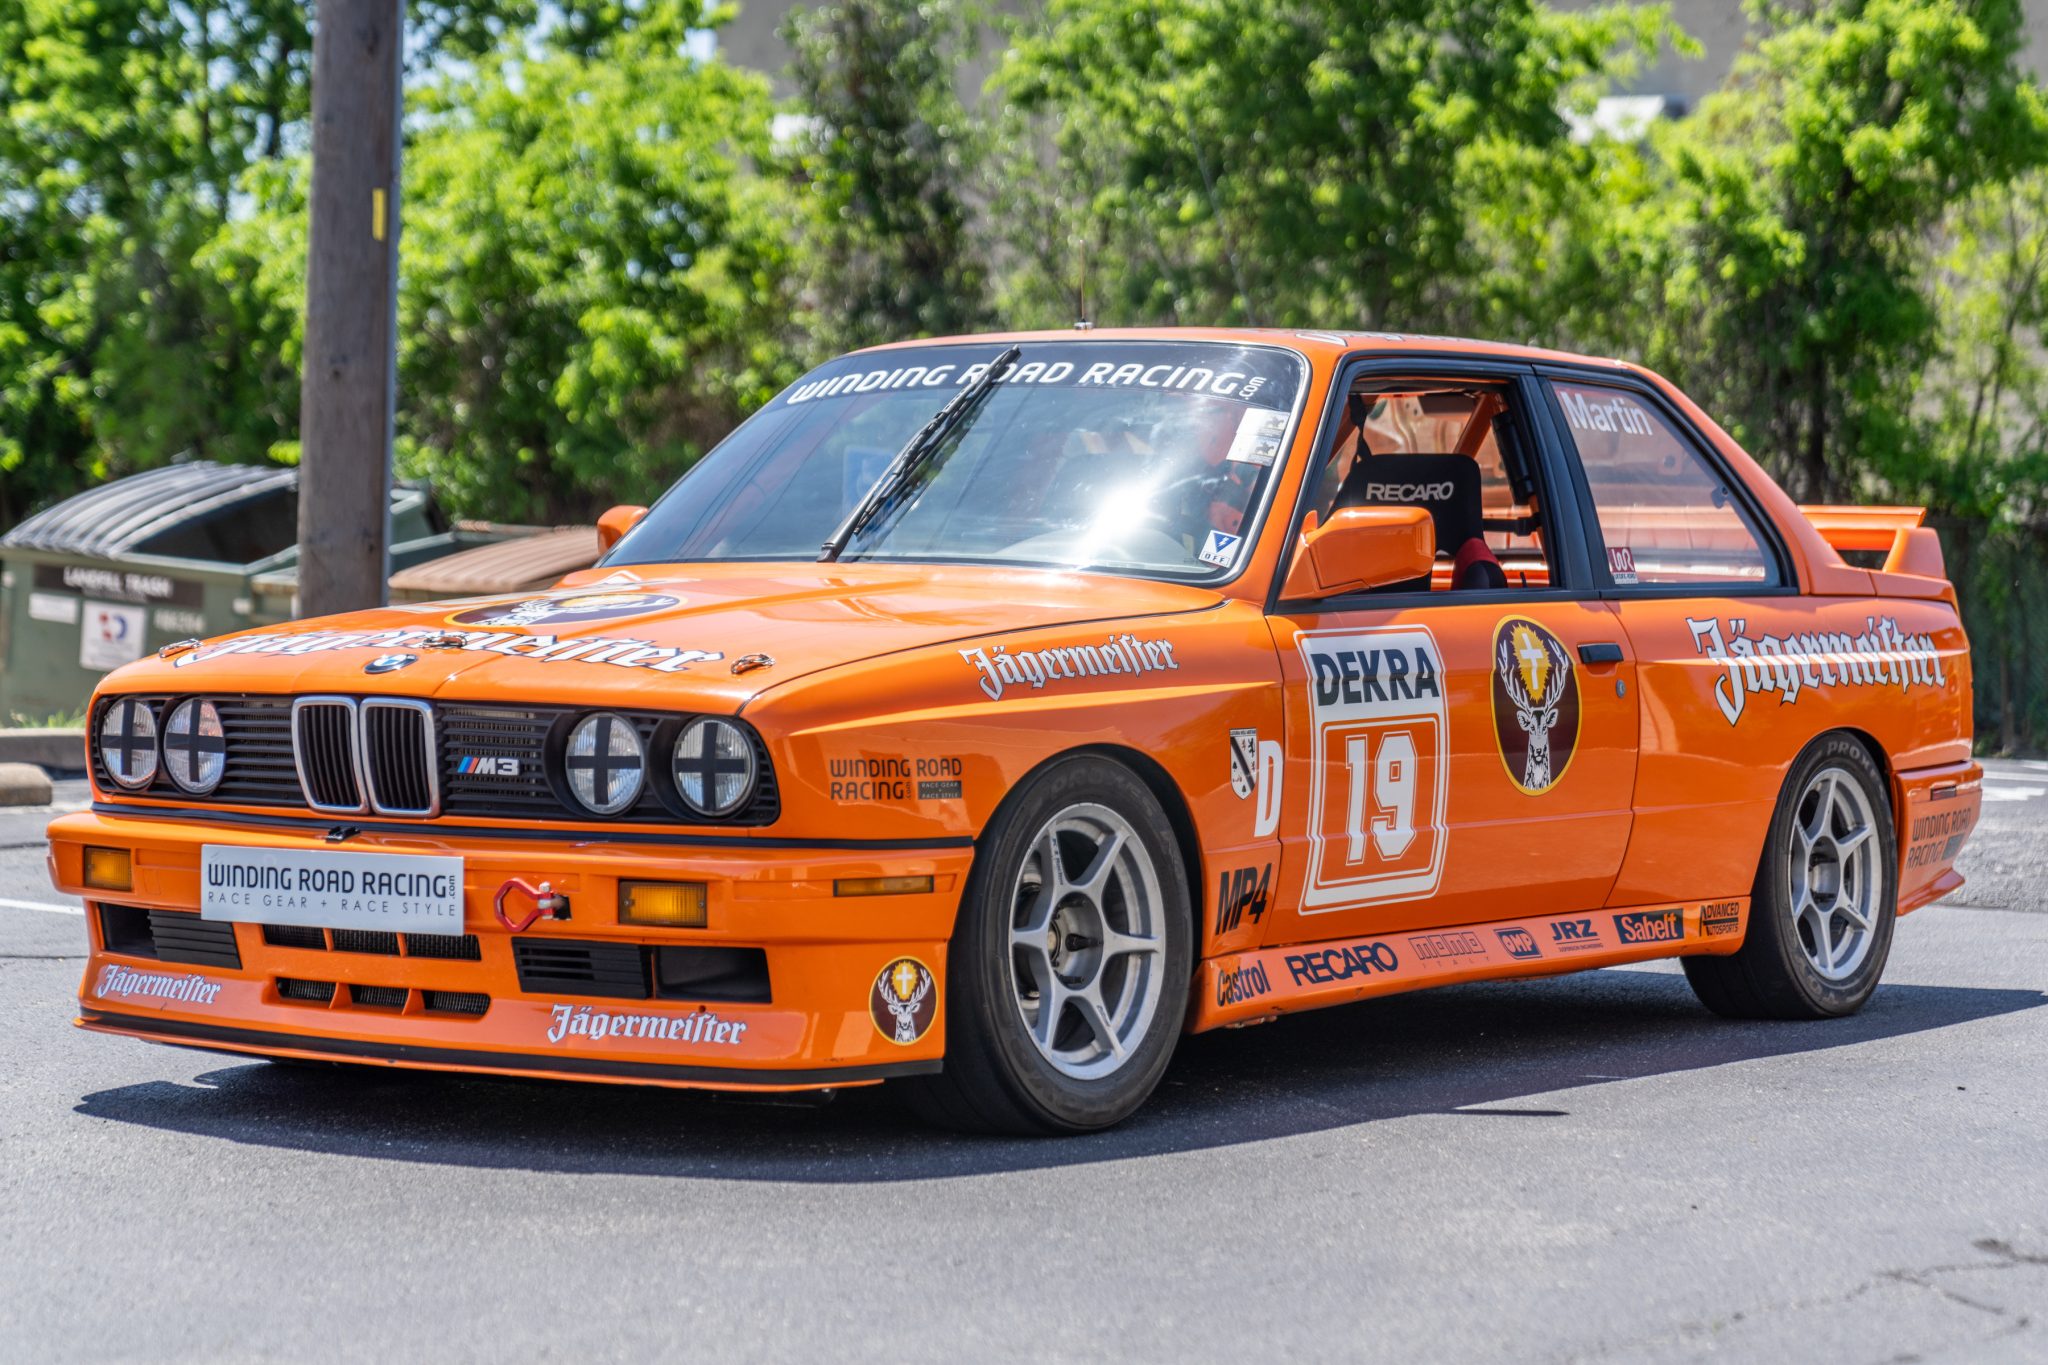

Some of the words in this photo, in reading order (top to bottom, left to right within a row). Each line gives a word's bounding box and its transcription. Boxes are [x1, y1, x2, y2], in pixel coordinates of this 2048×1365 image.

[787, 365, 956, 402] WINDING
[1079, 362, 1246, 395] RACING
[1559, 391, 1654, 435] Martin
[1365, 481, 1454, 501] RECARO
[1204, 553, 1226, 563] OFF
[1310, 647, 1440, 706] DEKRA
[474, 757, 519, 776] M3
[830, 758, 911, 778] WINDING
[916, 758, 963, 777] ROAD
[831, 781, 904, 800] RACING
[1253, 740, 1283, 838] D
[1345, 730, 1418, 866] 19
[1912, 813, 1951, 843] WINDING
[1906, 841, 1944, 872] RACING
[207, 863, 292, 890] WINDING
[299, 869, 355, 893] ROAD
[362, 872, 446, 898] RACING
[448, 875, 456, 900] .com
[207, 891, 251, 905] RACE
[262, 894, 308, 908] GEAR
[341, 899, 389, 913] RACE
[402, 902, 456, 917] STYLE
[1216, 862, 1273, 934] MP4
[1550, 919, 1598, 941] JRZ
[1620, 912, 1679, 942] Sabelt
[1501, 933, 1533, 953] OMP
[1284, 942, 1399, 987] RECARO
[1216, 959, 1272, 1008] Castrol
